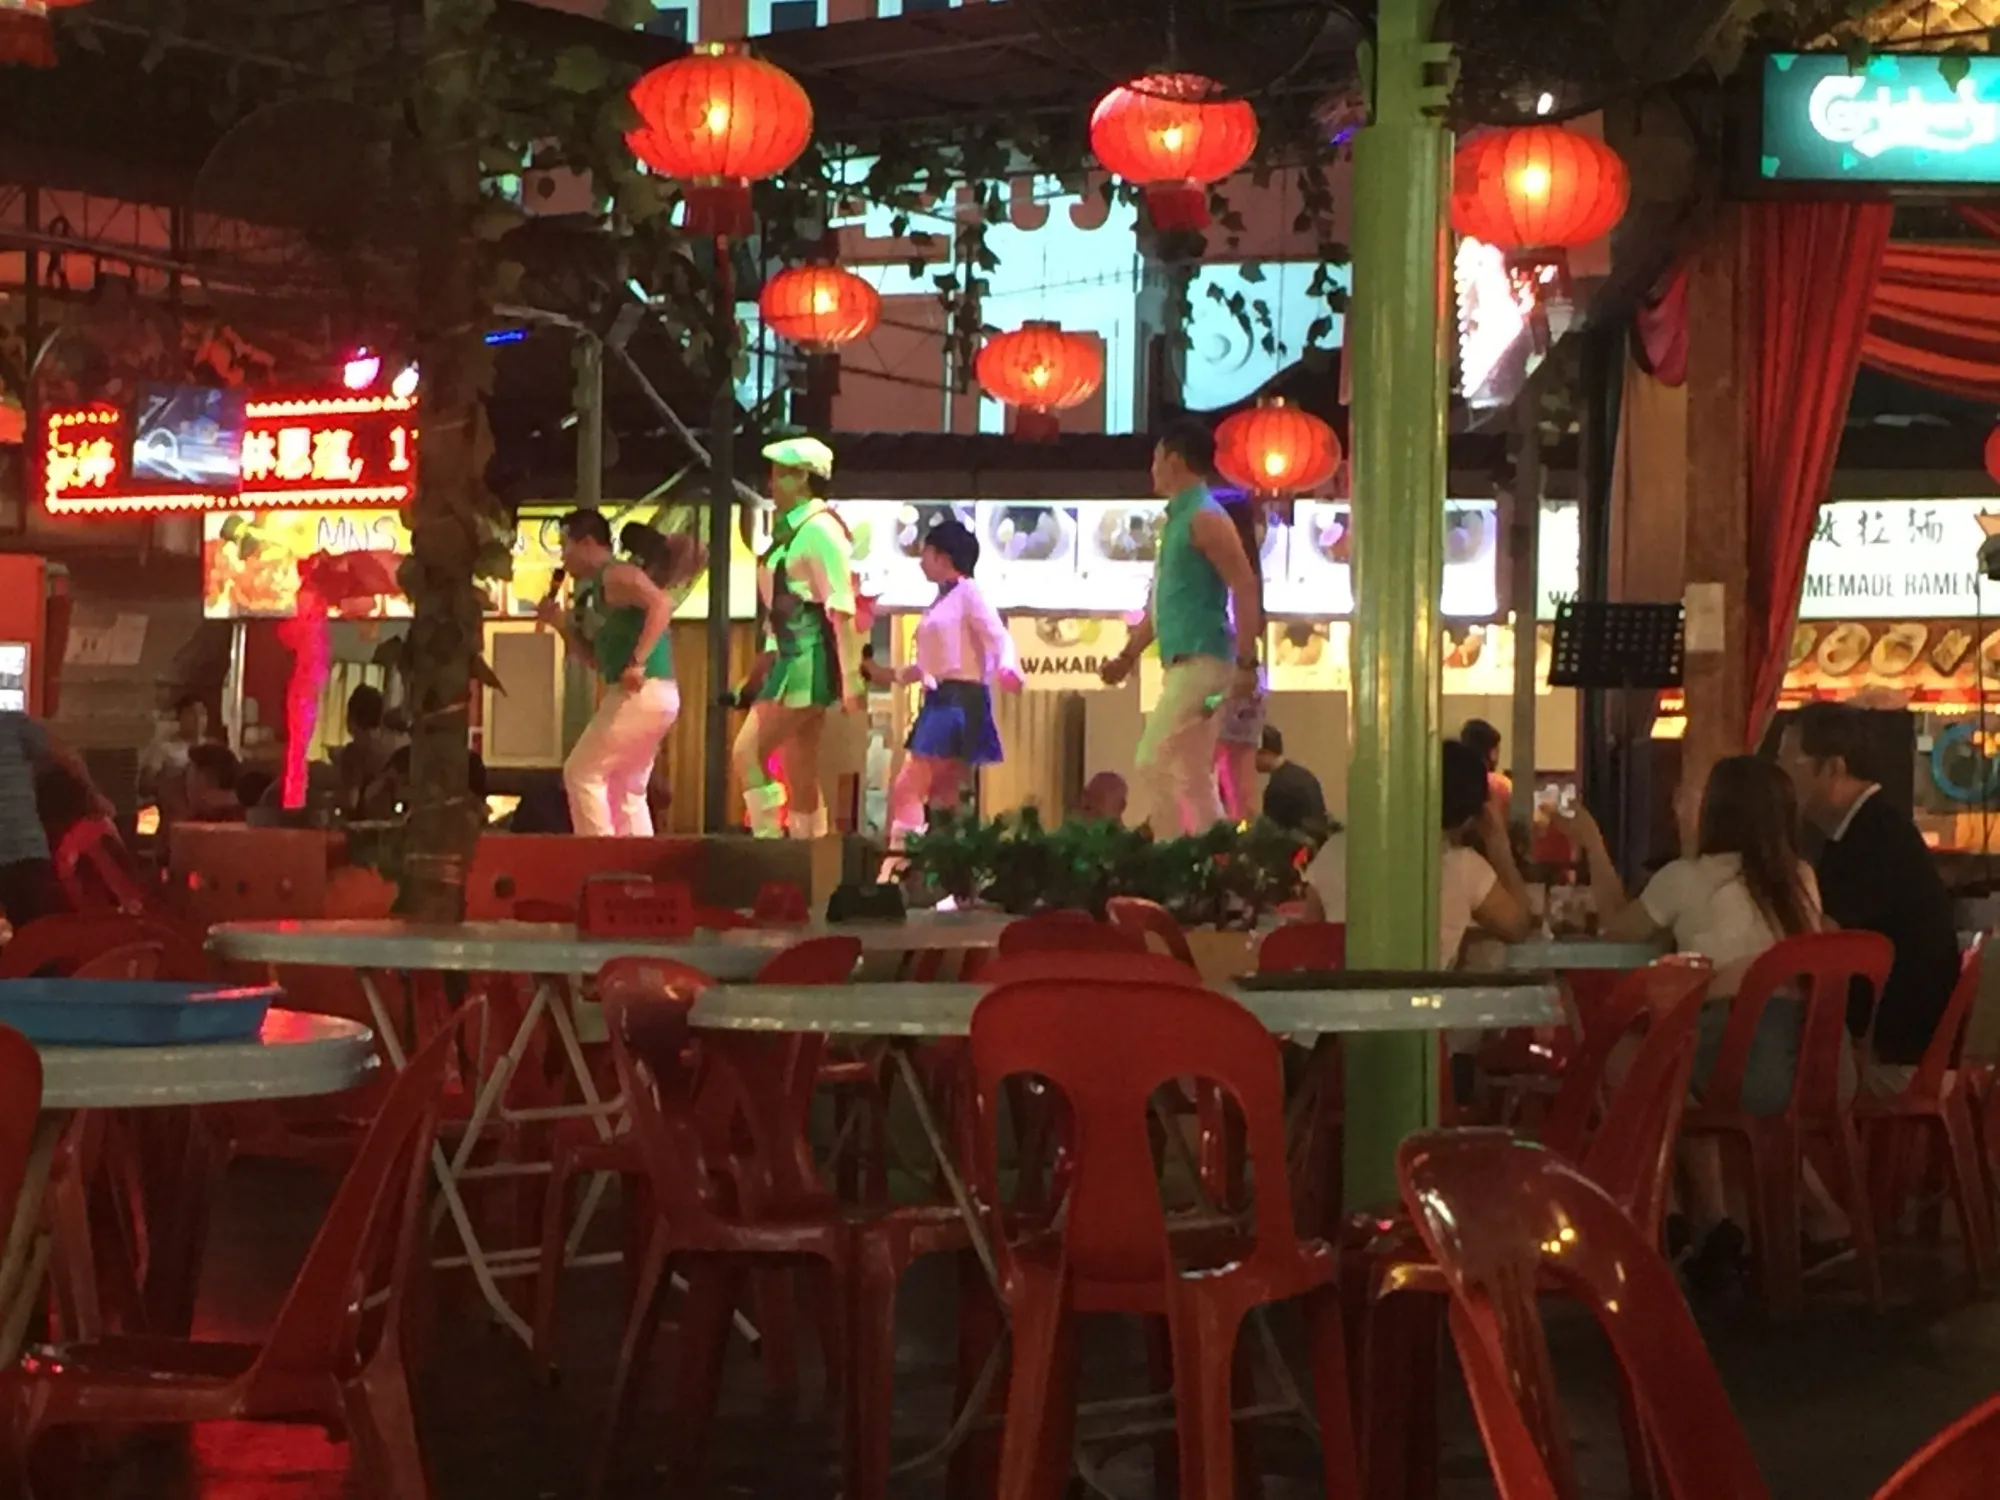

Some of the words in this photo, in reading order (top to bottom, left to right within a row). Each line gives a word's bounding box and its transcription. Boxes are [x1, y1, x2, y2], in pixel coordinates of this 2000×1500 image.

[1807, 573, 1893, 597] MEMADE
[1905, 572, 1980, 596] RAMEN
[1020, 655, 1108, 674] WAKAB
